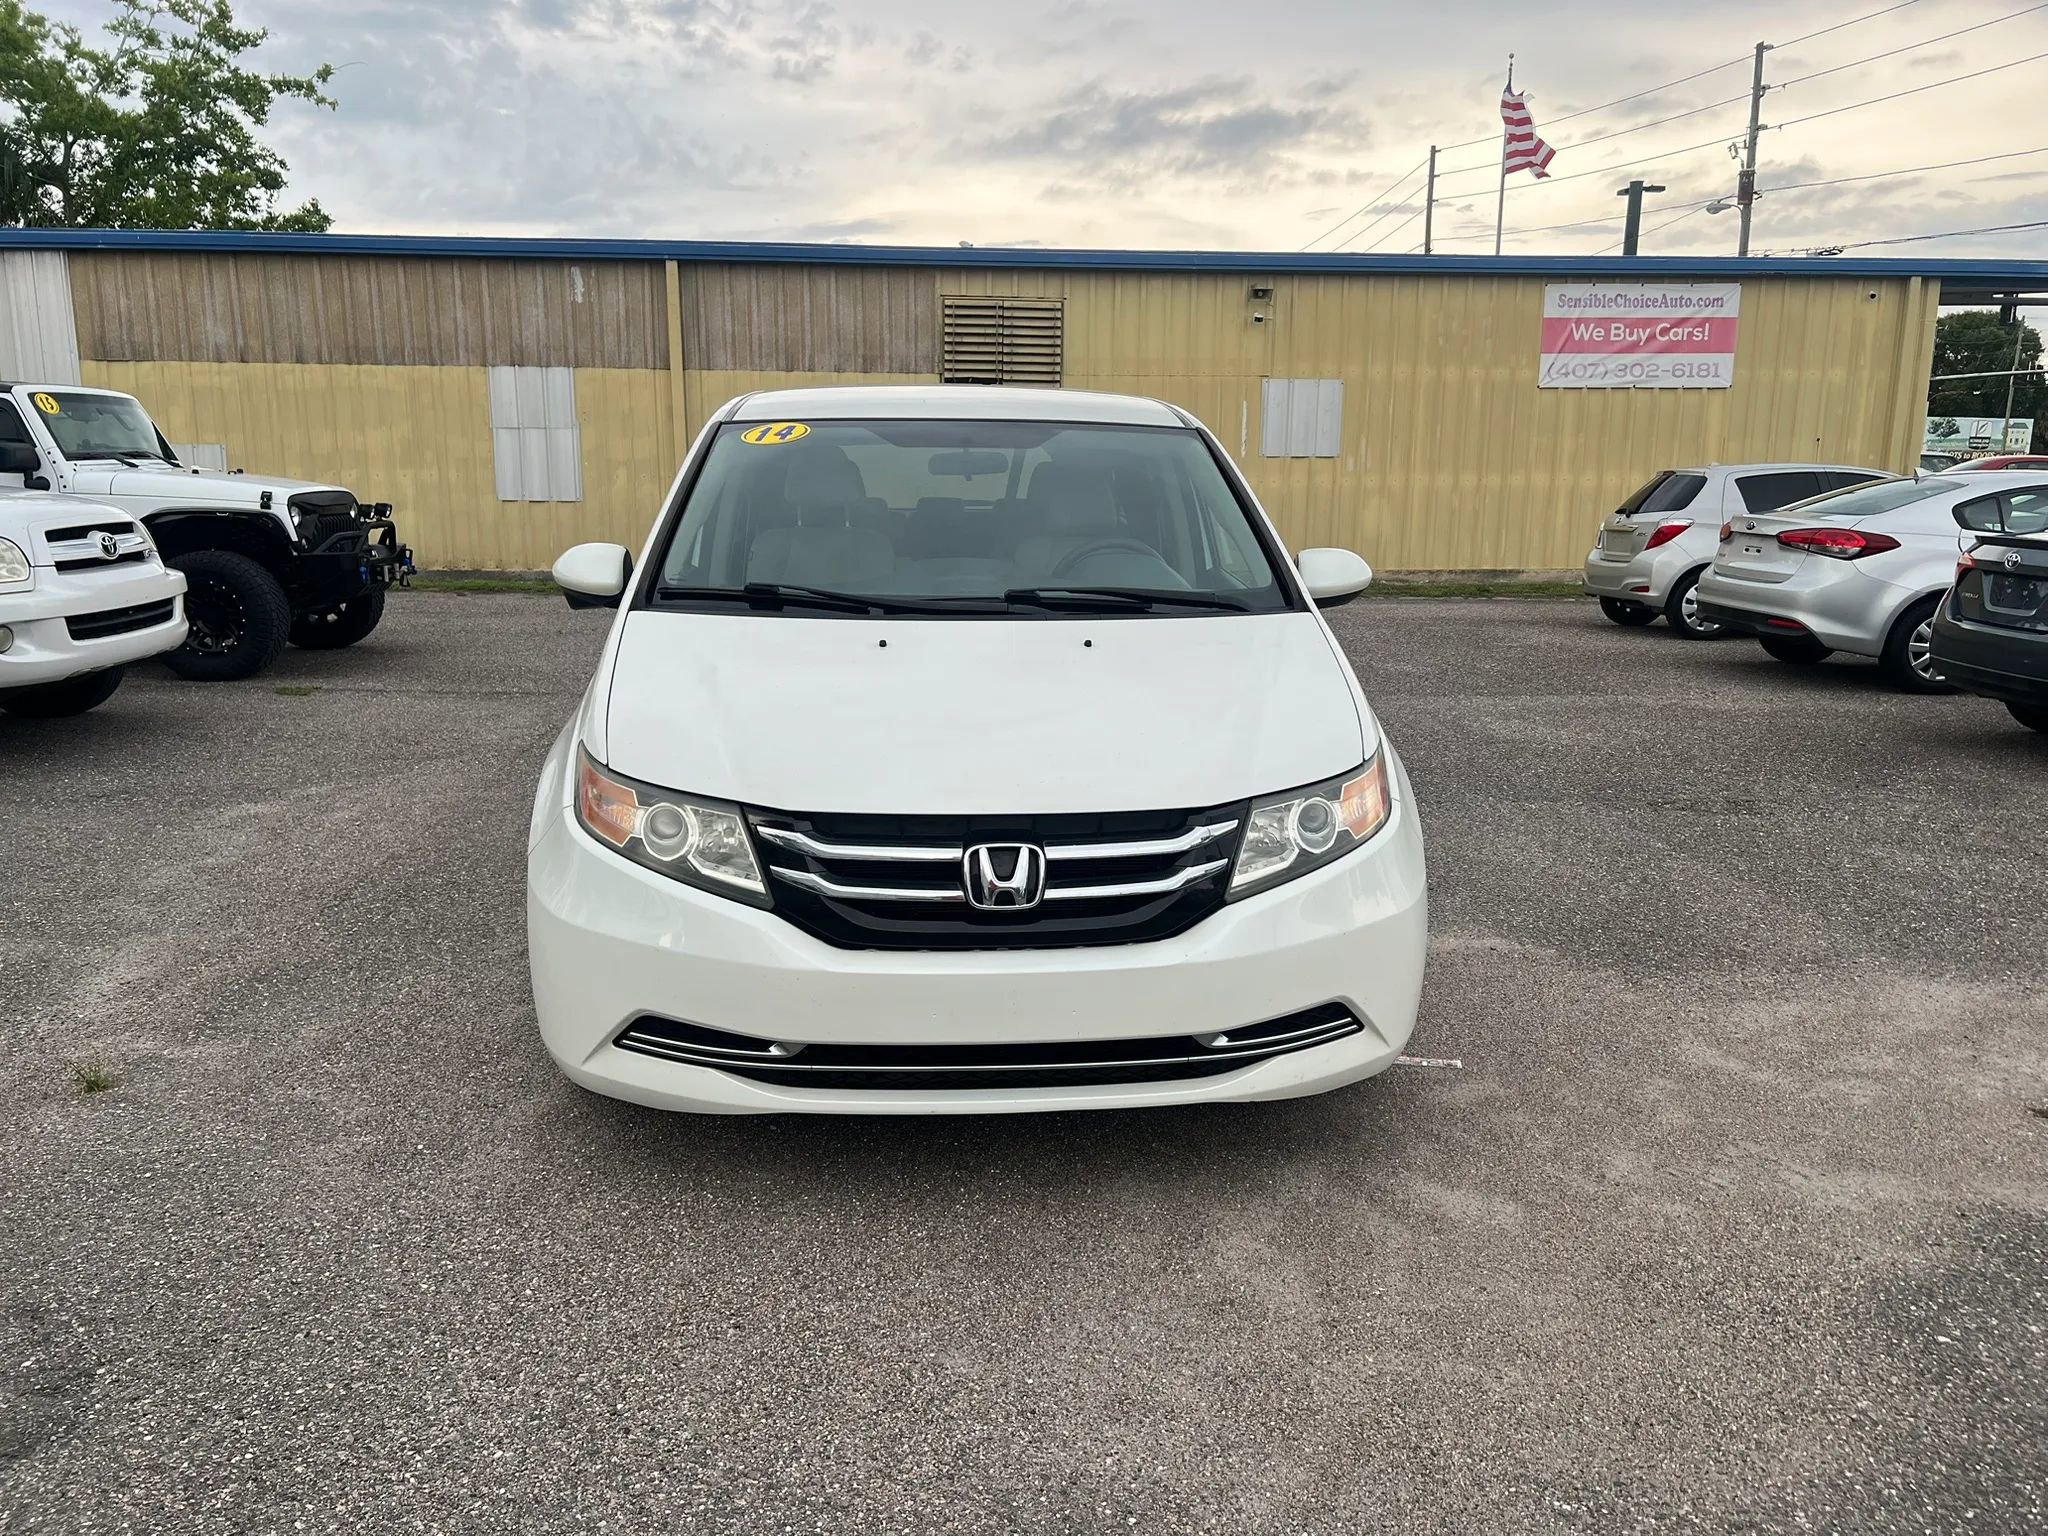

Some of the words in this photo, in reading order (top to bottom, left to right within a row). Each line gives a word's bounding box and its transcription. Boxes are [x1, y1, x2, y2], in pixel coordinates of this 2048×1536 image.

[1557, 293, 1724, 309] SensibleChoiceAuto.com
[1571, 323, 1605, 341] We
[1610, 323, 1650, 345] Buy
[1655, 323, 1709, 341] Cars!
[1547, 362, 1608, 380] (407)
[1613, 362, 1721, 379] 302-6181
[39, 396, 55, 411] 15
[755, 425, 797, 442] 14
